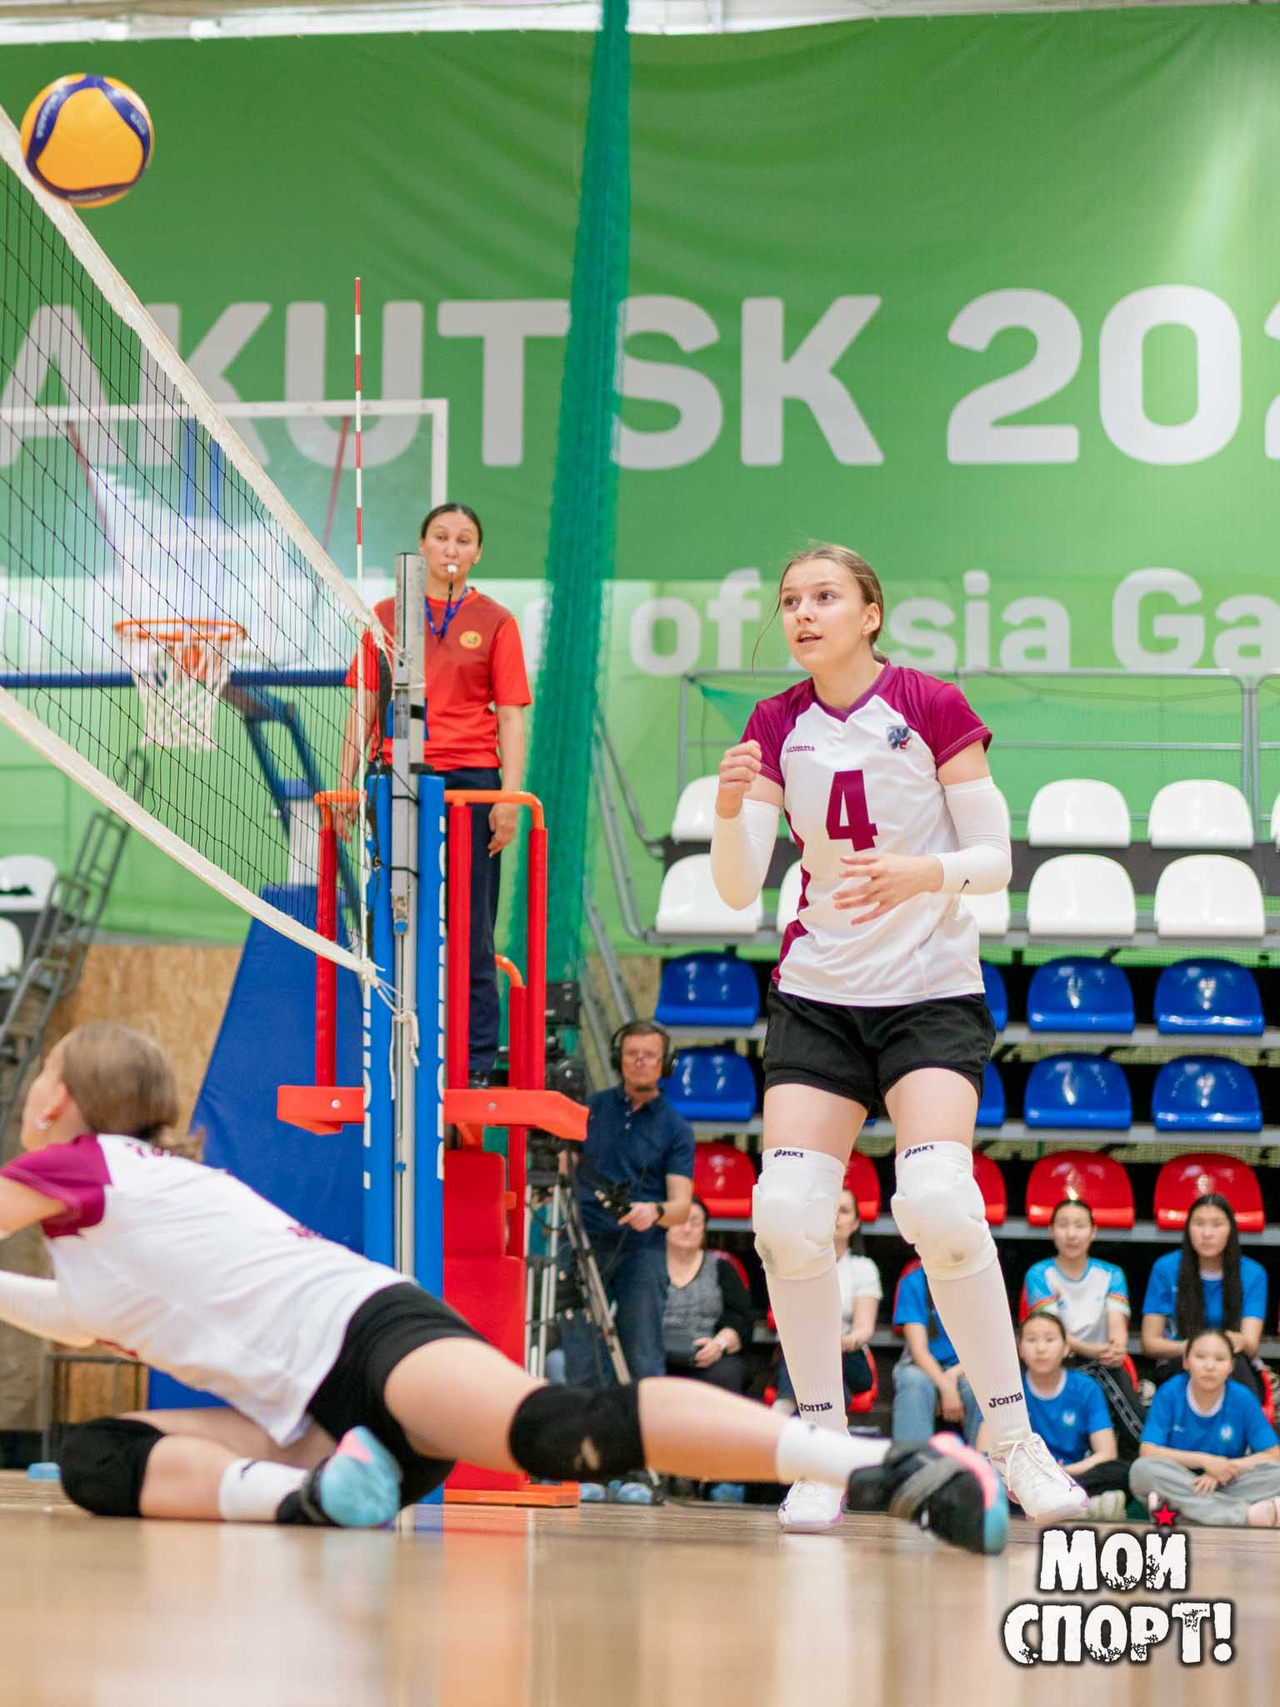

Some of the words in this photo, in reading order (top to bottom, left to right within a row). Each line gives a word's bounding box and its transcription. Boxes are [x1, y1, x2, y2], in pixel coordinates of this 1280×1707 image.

[947, 284, 1280, 466] 20
[629, 568, 762, 677] of
[786, 569, 1072, 672] sia
[825, 769, 878, 852] 4
[989, 1391, 1023, 1408] Joma
